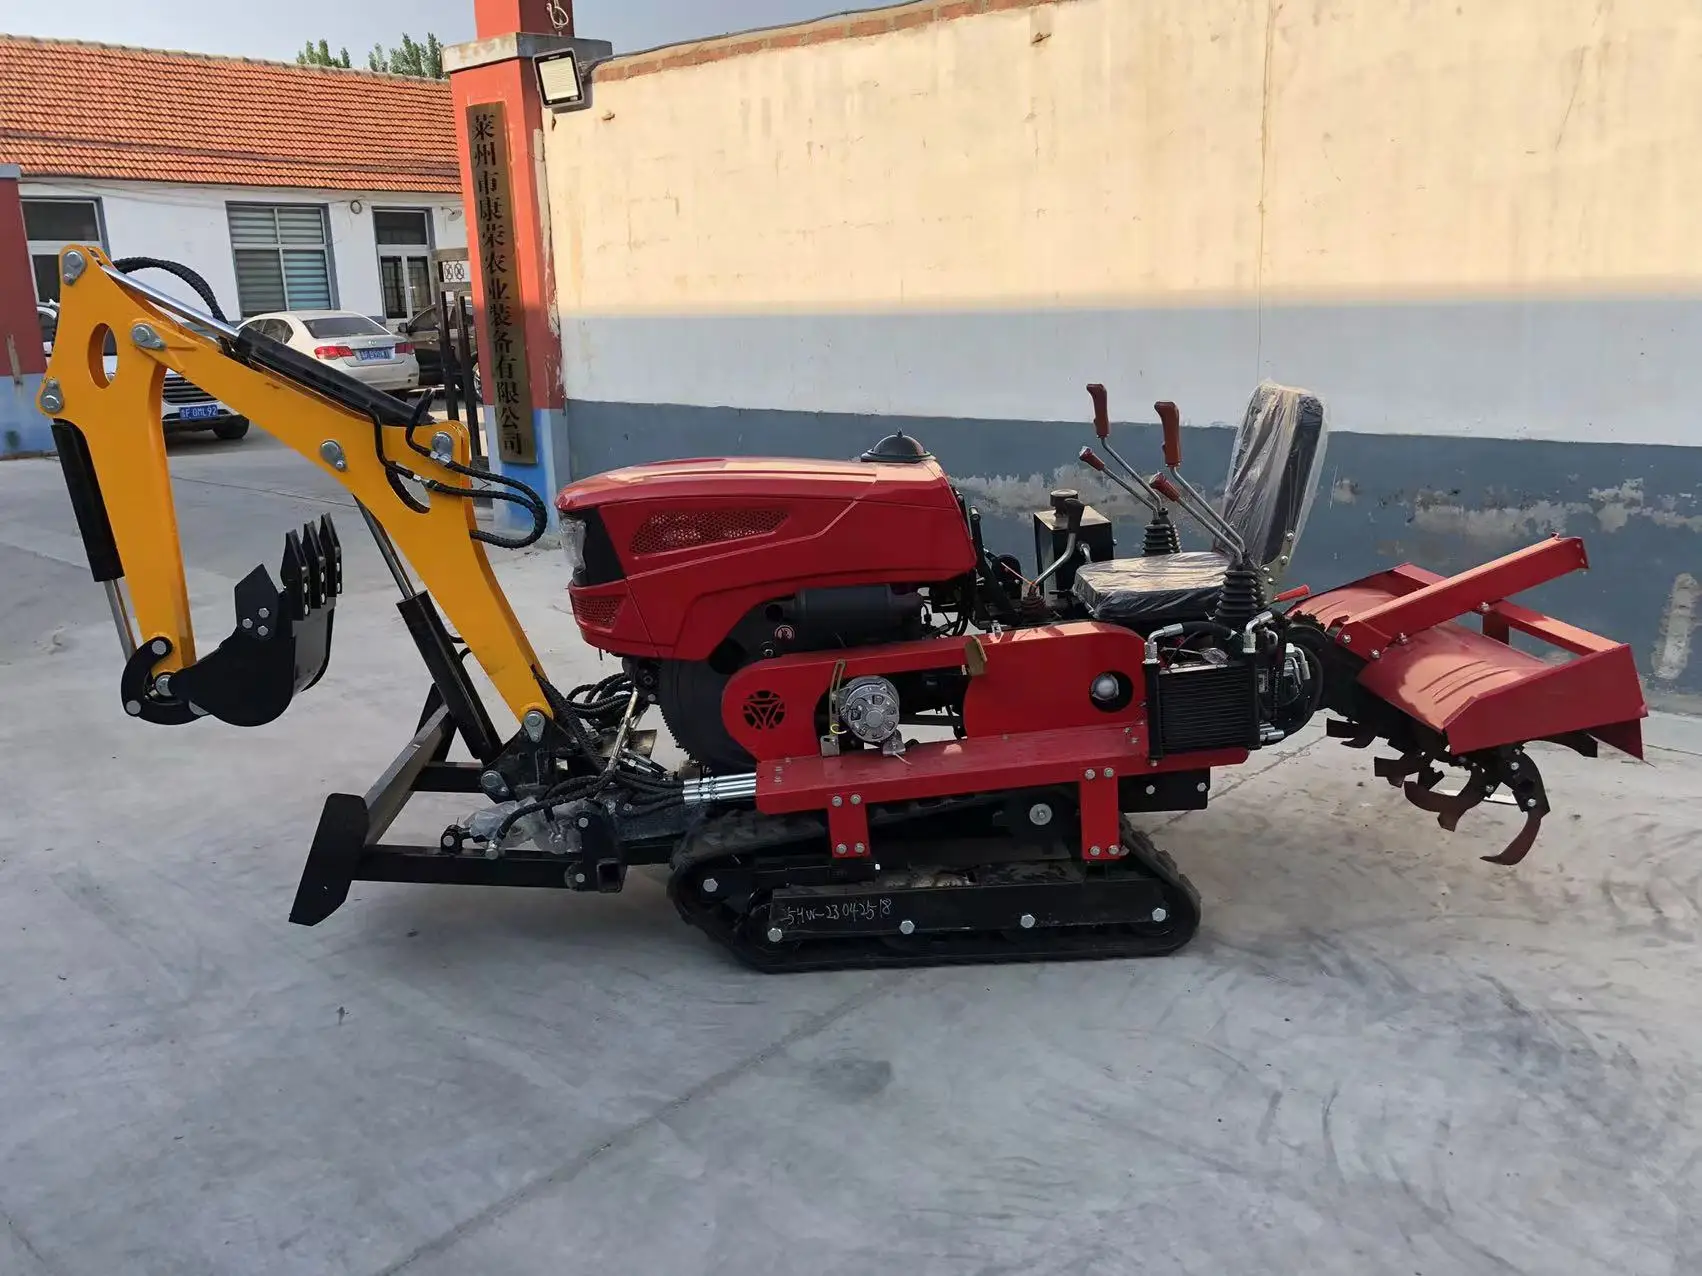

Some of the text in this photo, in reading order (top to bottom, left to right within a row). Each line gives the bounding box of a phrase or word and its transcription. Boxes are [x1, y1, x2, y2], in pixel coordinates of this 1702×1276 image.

[472, 113, 522, 456] 莱州市康荣农业装备有限公司
